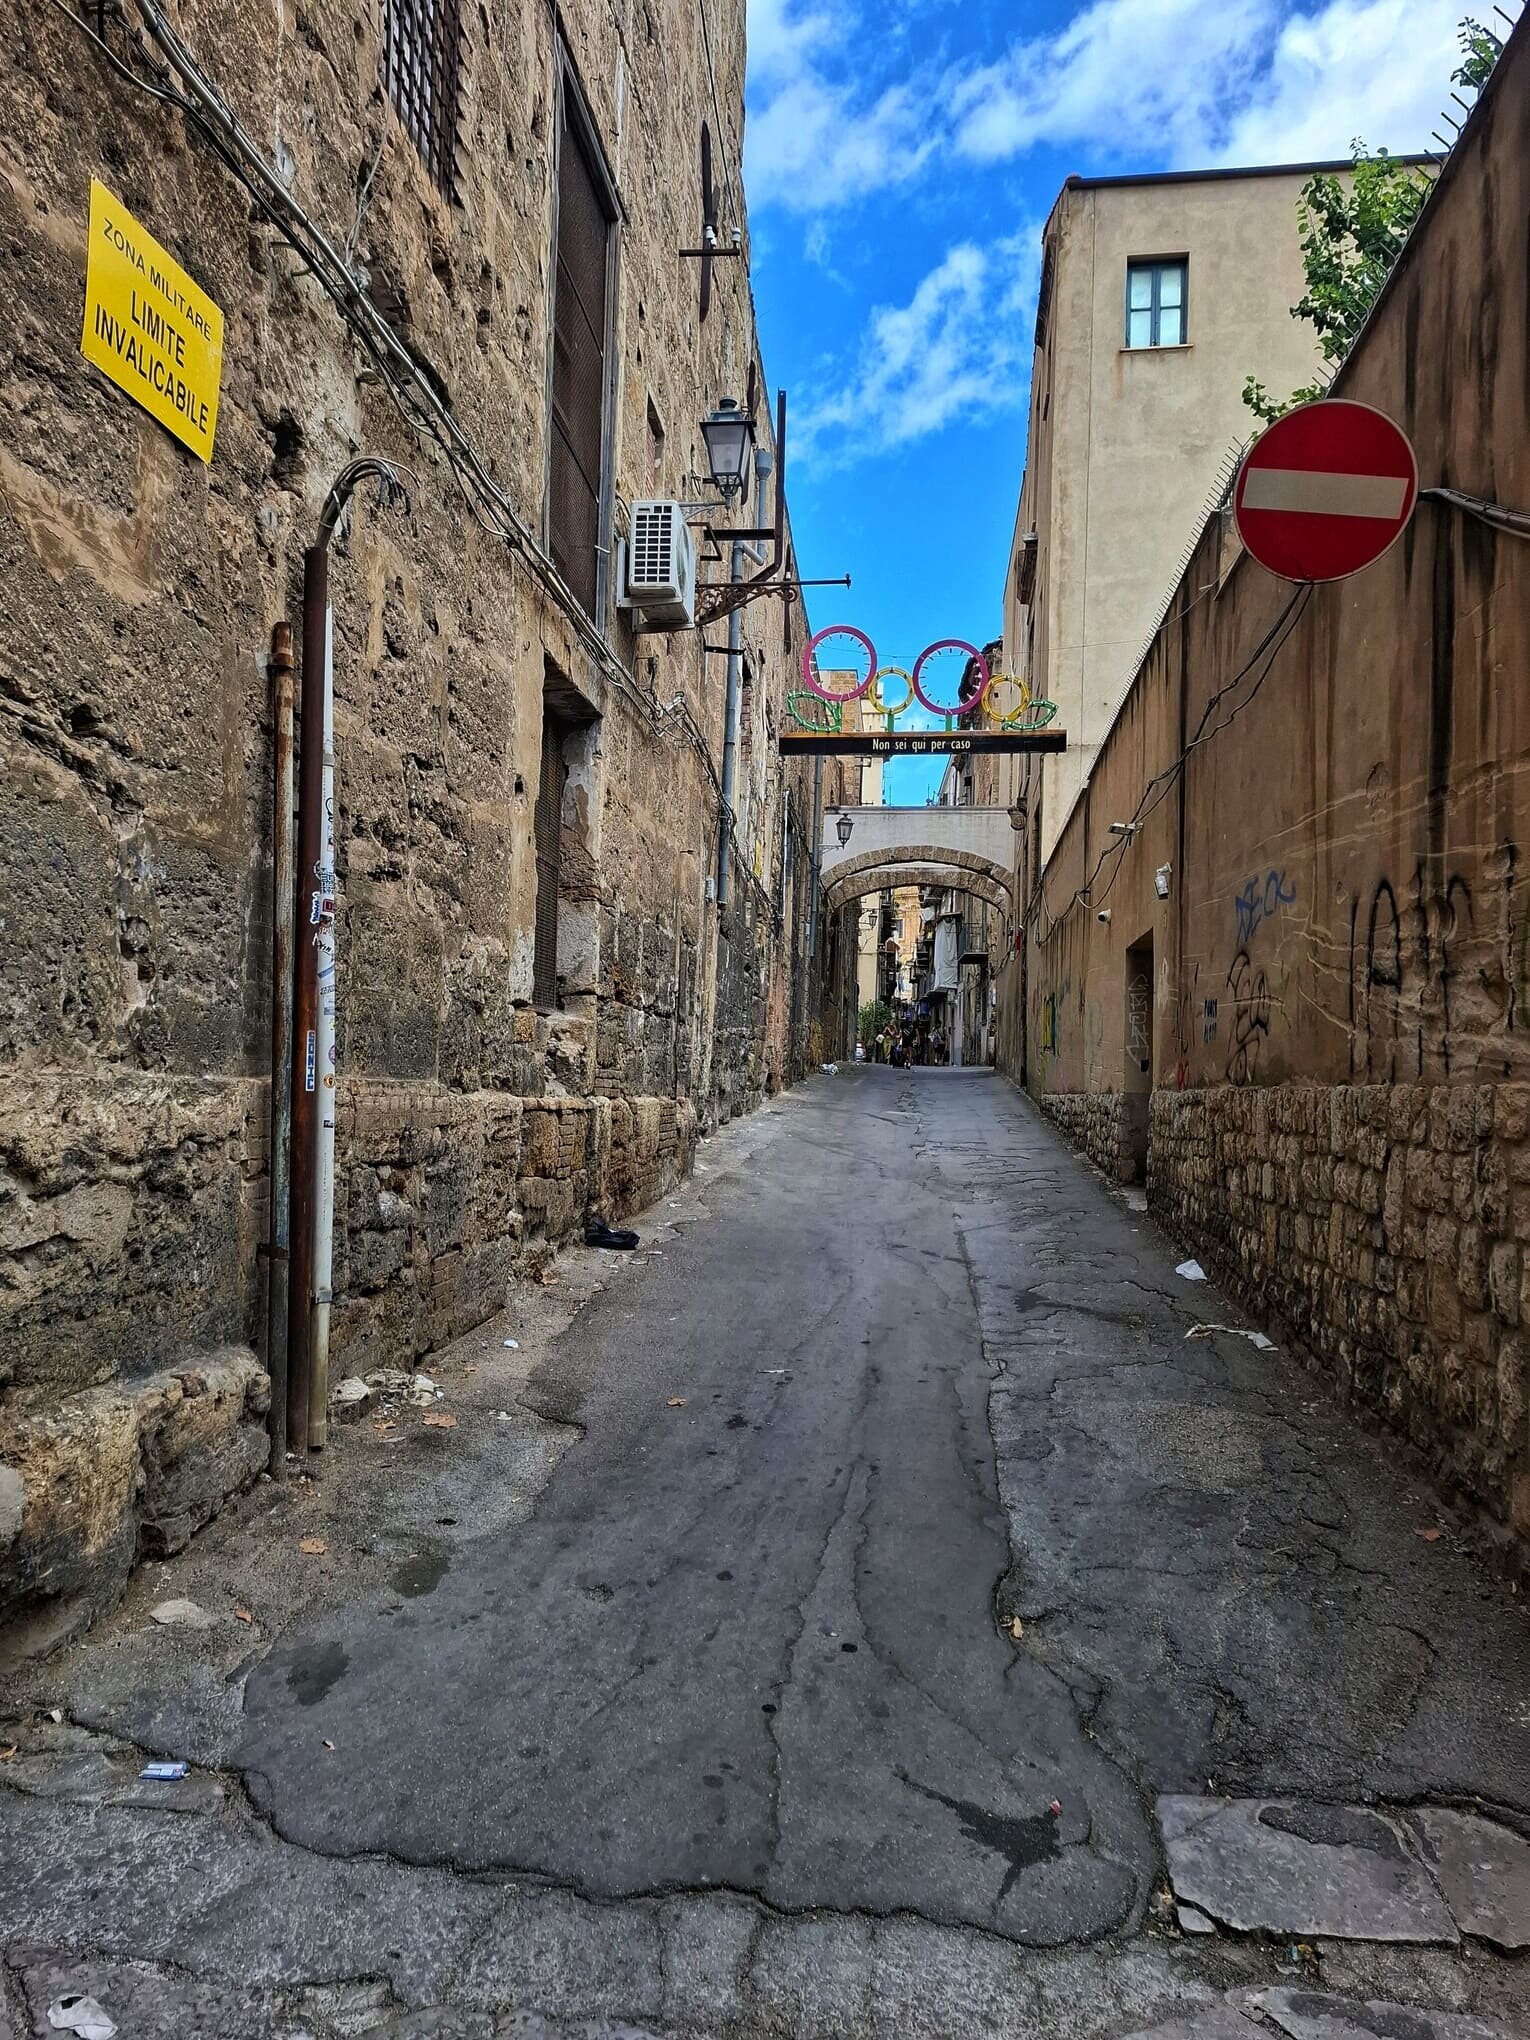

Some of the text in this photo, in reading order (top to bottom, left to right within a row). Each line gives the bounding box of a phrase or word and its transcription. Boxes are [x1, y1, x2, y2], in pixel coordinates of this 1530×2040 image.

[103, 217, 212, 342] ZONA MILITARE
[131, 290, 185, 368] LIMITE
[95, 303, 209, 435] INVALICABILE
[872, 737, 971, 752] Non sei qui per caso
